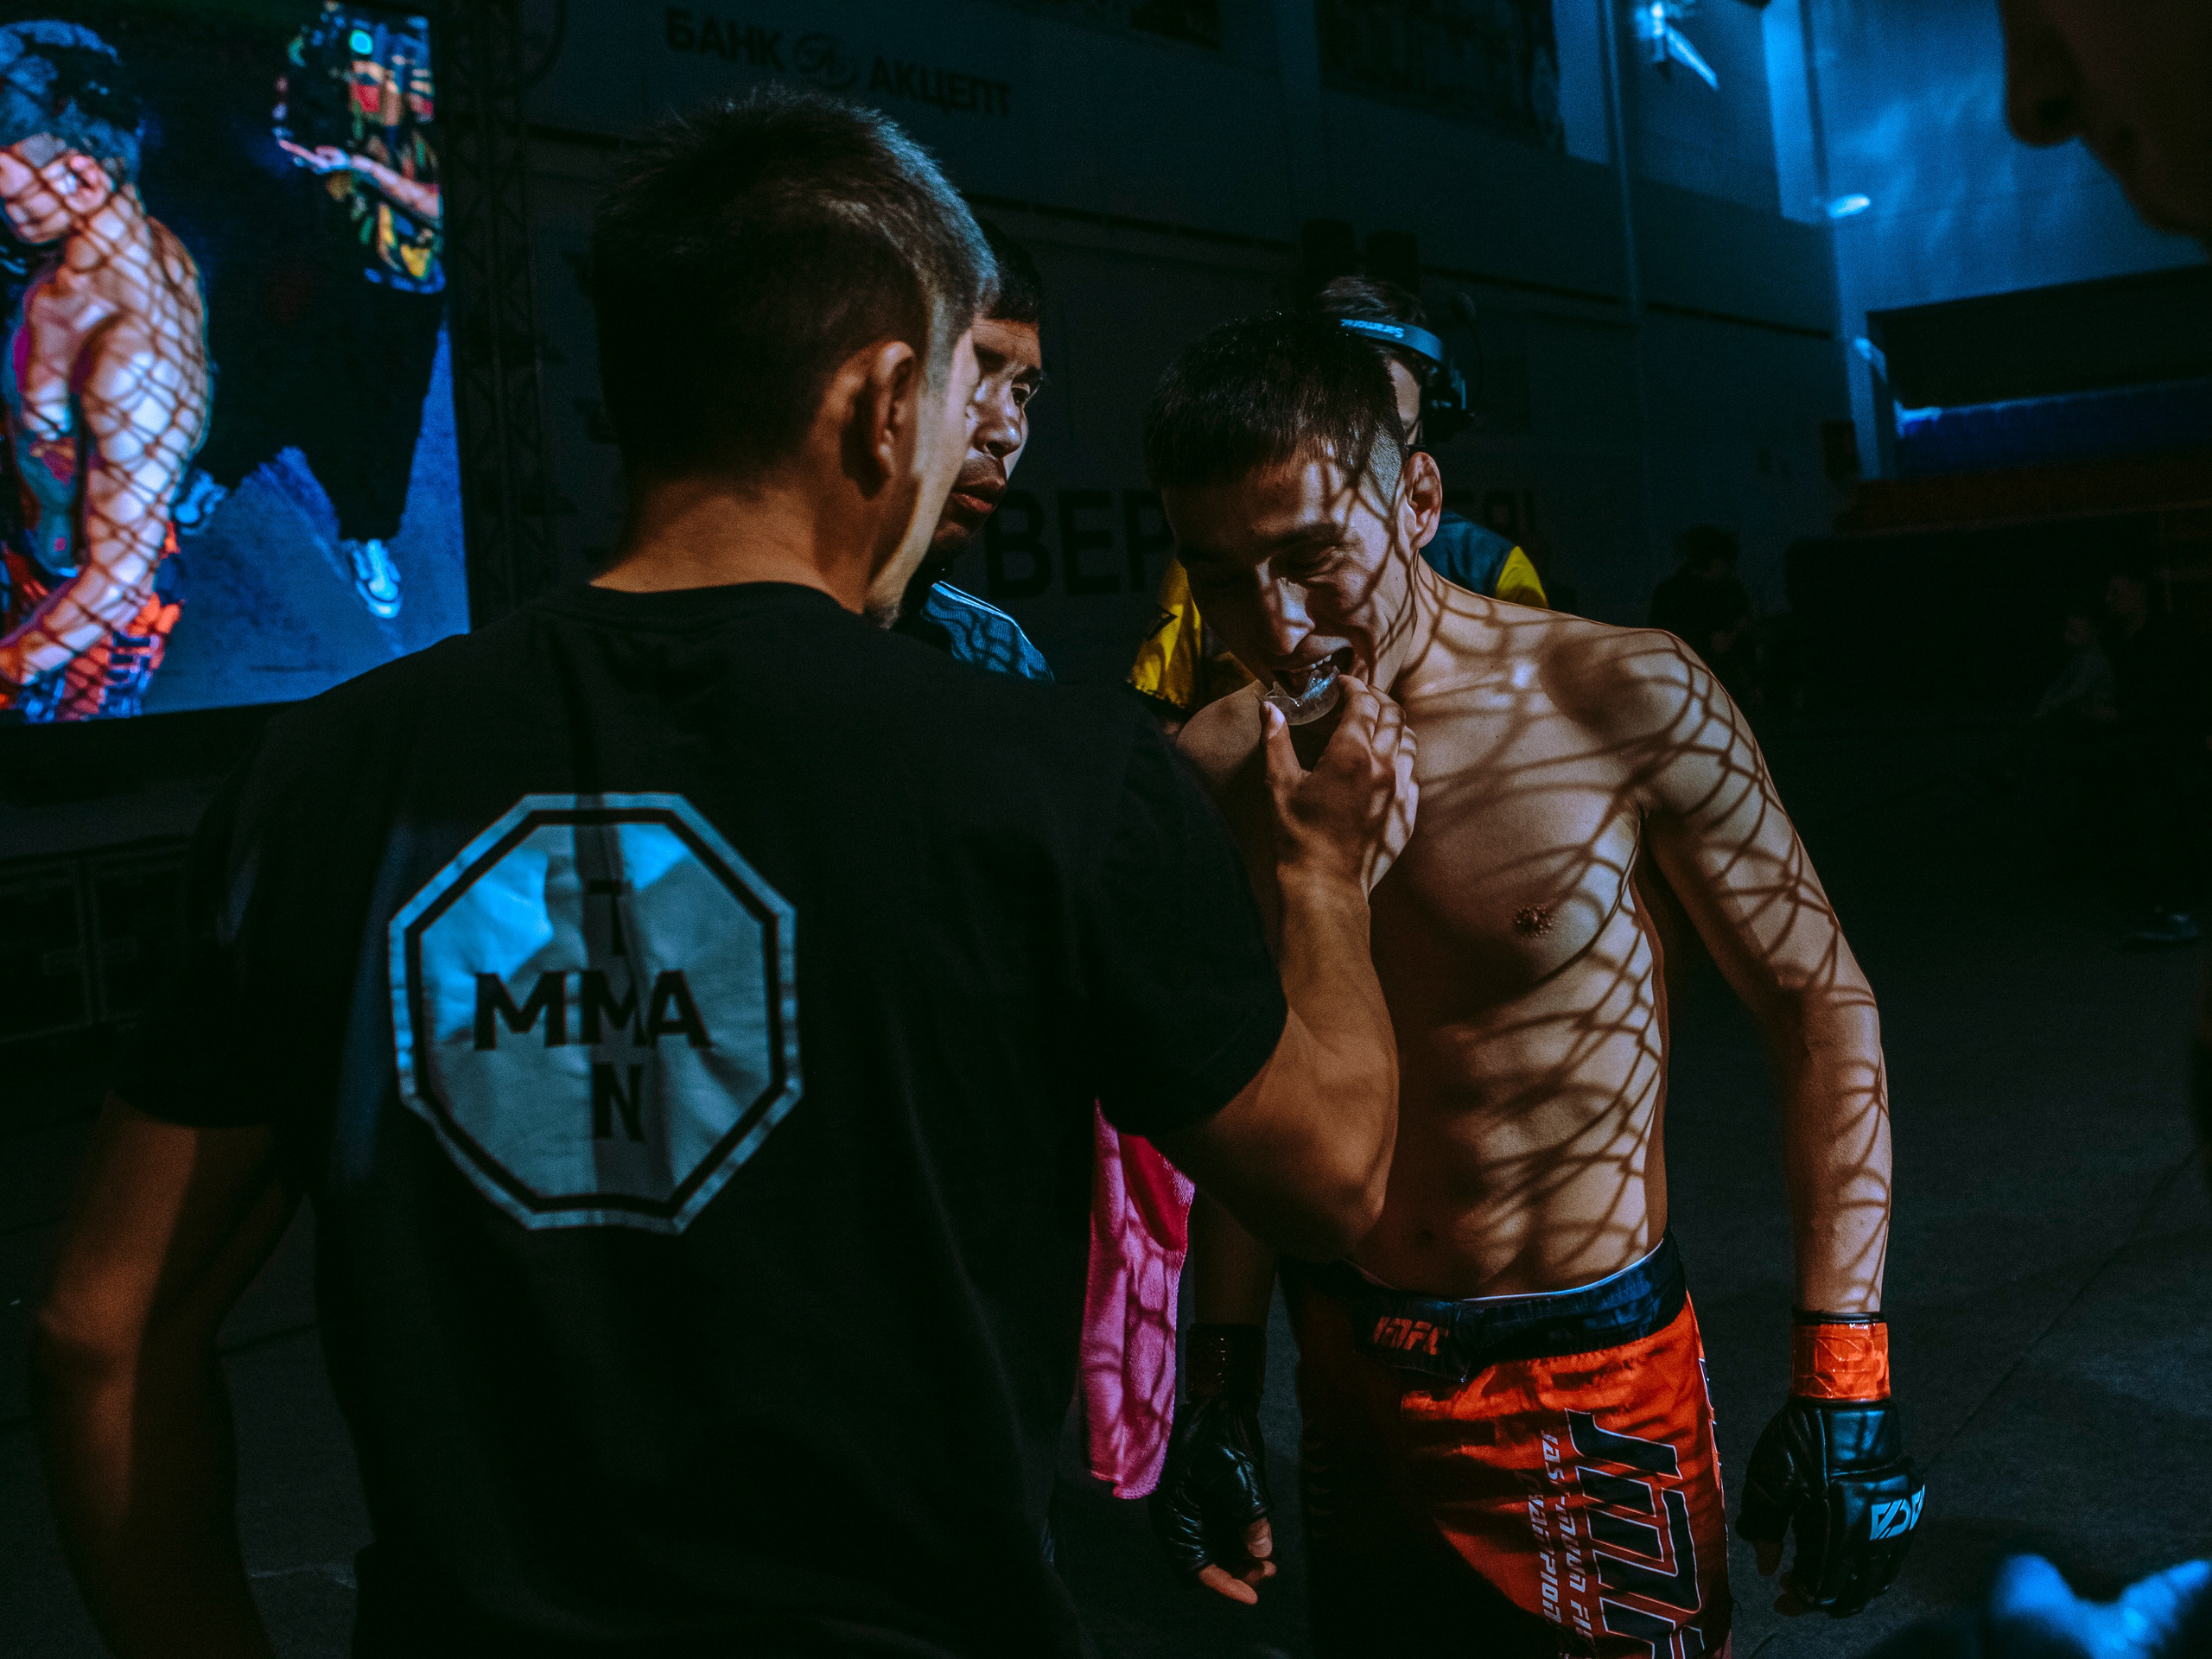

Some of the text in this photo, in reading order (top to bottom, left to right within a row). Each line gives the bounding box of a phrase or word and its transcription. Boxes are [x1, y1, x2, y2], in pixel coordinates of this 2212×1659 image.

[666, 7, 1012, 117] БАНК АКЦЕПТ
[474, 969, 712, 1050] MMA
